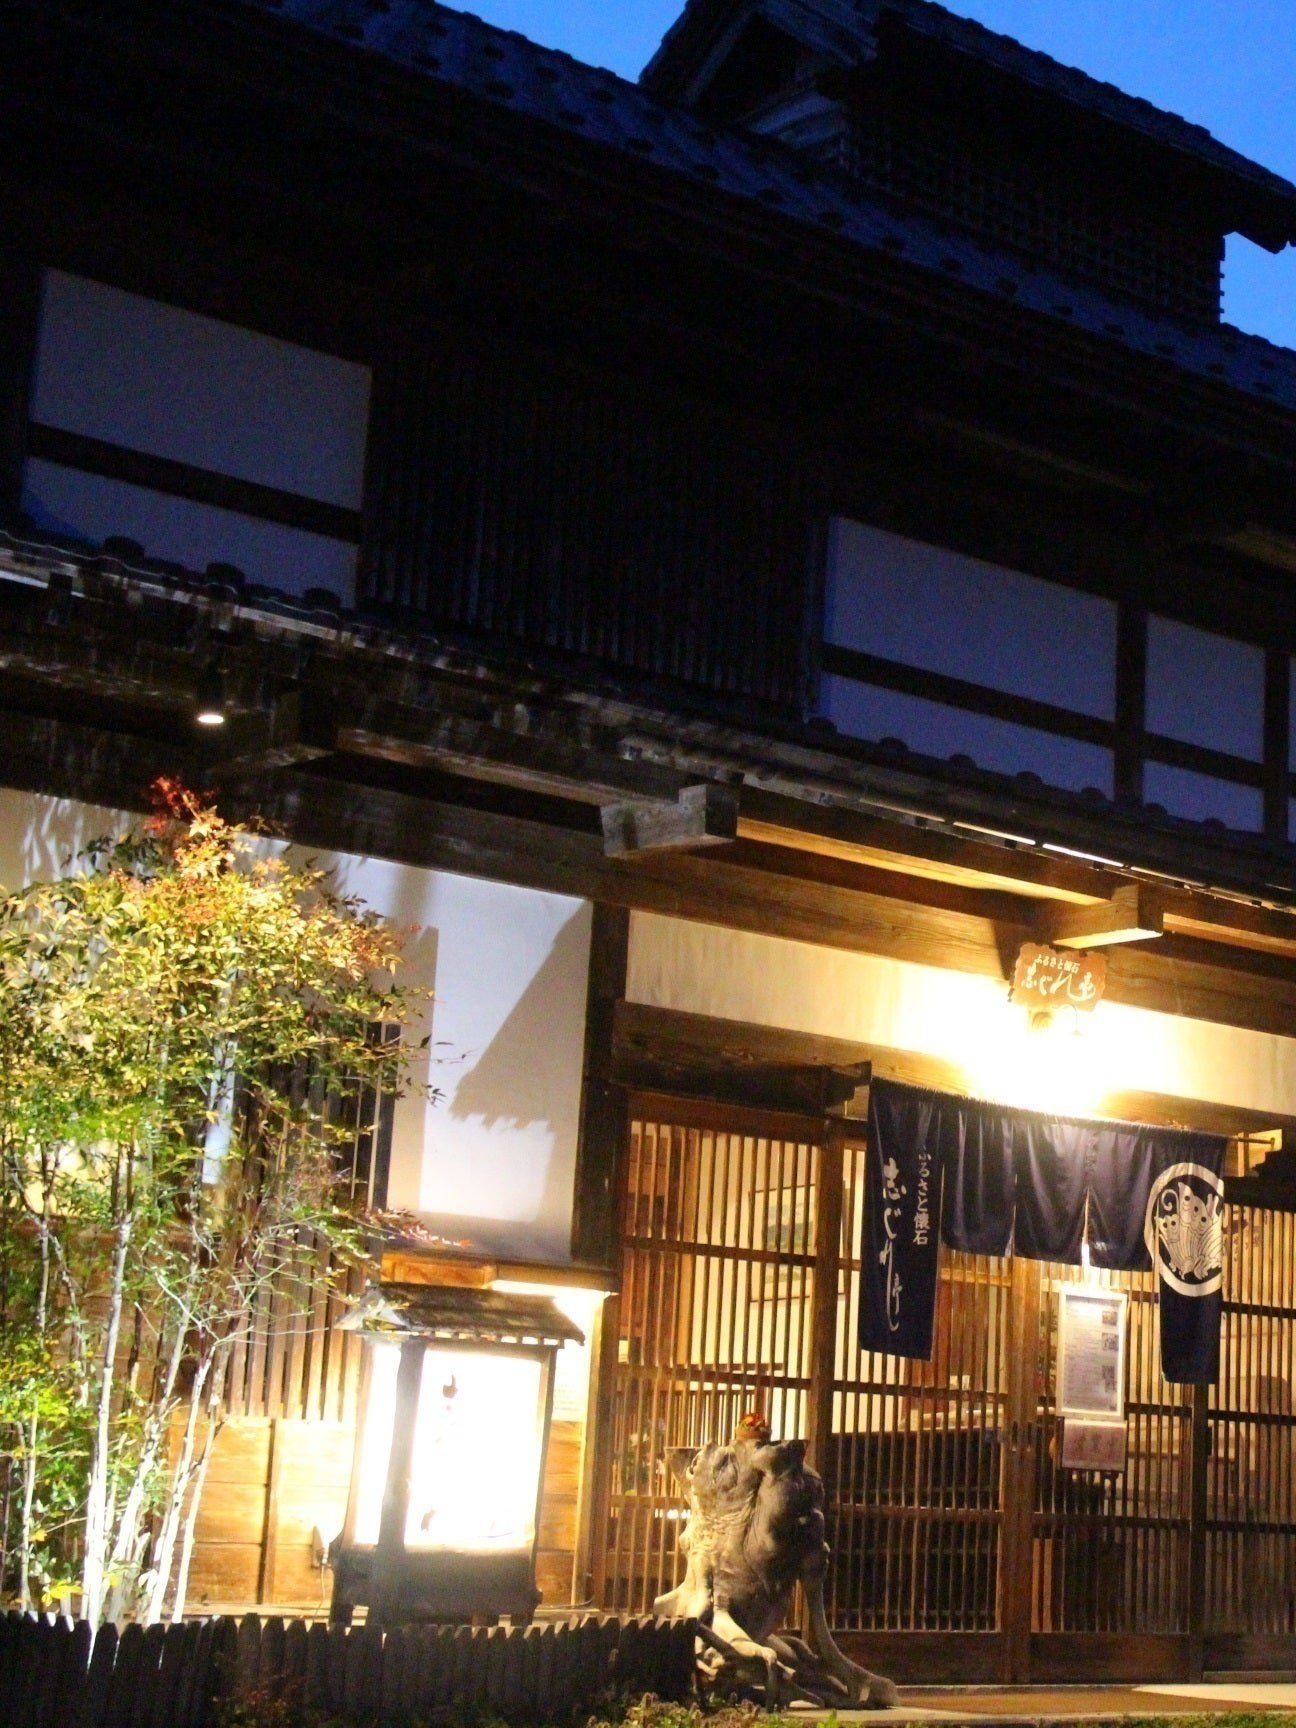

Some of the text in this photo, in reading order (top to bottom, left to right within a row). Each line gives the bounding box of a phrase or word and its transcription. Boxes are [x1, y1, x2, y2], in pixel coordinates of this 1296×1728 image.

[913, 1145, 931, 1245] ふるさと懐石
